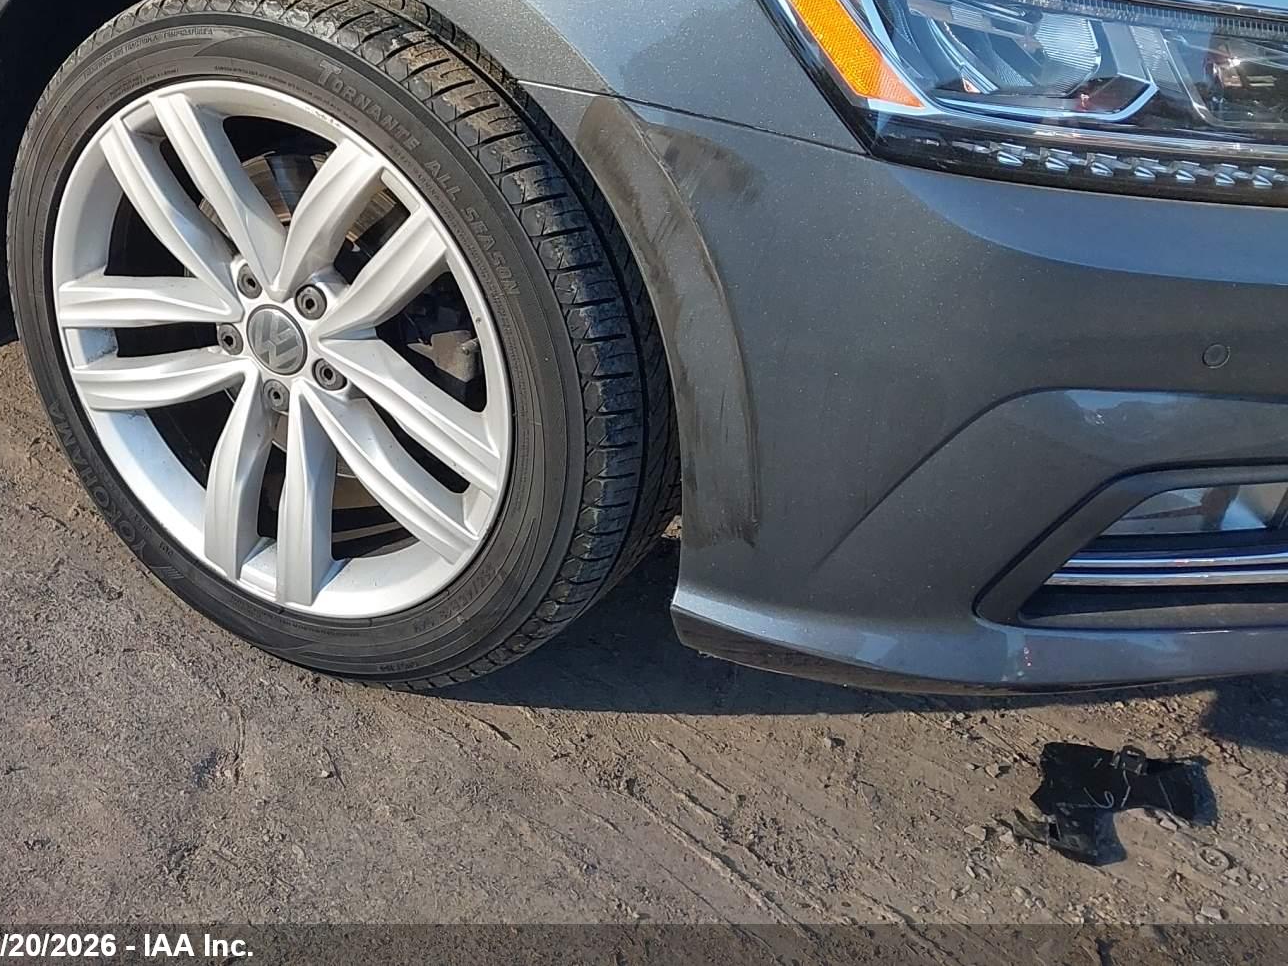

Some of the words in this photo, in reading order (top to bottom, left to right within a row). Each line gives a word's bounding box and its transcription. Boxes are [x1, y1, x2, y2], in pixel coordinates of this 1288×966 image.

[424, 159, 462, 202] ALL
[461, 206, 521, 295] SEASON
[48, 401, 146, 560] YOKOHAMA
